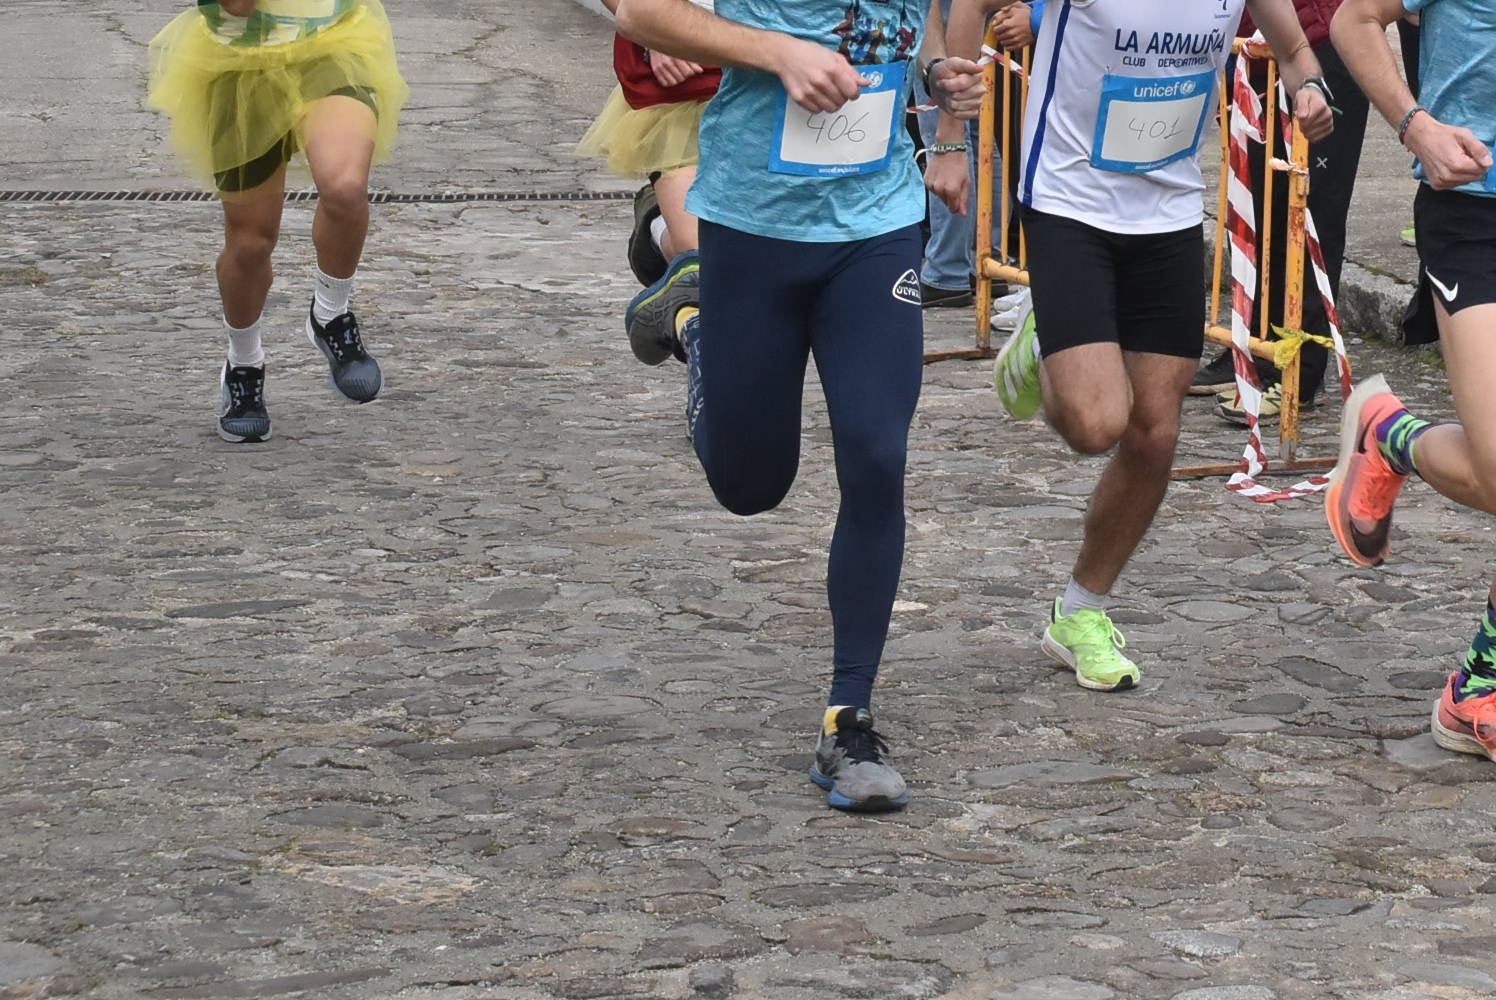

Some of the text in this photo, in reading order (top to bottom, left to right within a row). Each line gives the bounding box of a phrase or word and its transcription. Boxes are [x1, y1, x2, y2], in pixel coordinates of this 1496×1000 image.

[1115, 28, 1226, 55] LA ARMUÑA
[1122, 56, 1146, 67] CLUB
[1134, 82, 1181, 98] unicef
[806, 112, 869, 144] 406
[1128, 114, 1185, 141] 401
